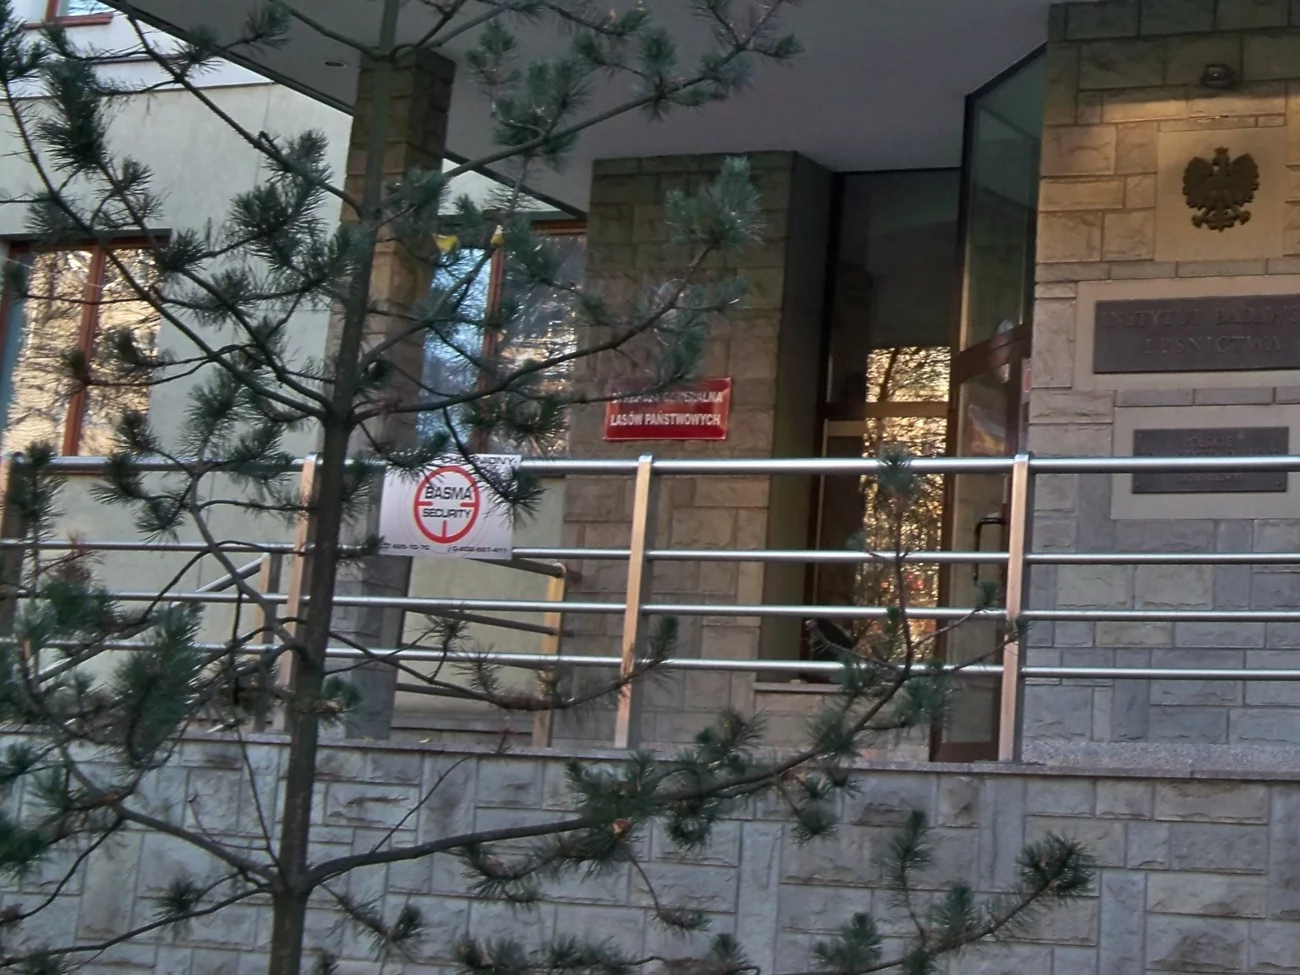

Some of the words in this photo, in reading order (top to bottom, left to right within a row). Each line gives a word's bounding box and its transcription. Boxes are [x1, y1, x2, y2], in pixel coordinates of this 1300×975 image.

[610, 411, 643, 426] LASÓW
[644, 410, 721, 426] PAŃSTWOWYCH
[425, 486, 472, 500] BASMA
[422, 508, 472, 518] SECURITY
